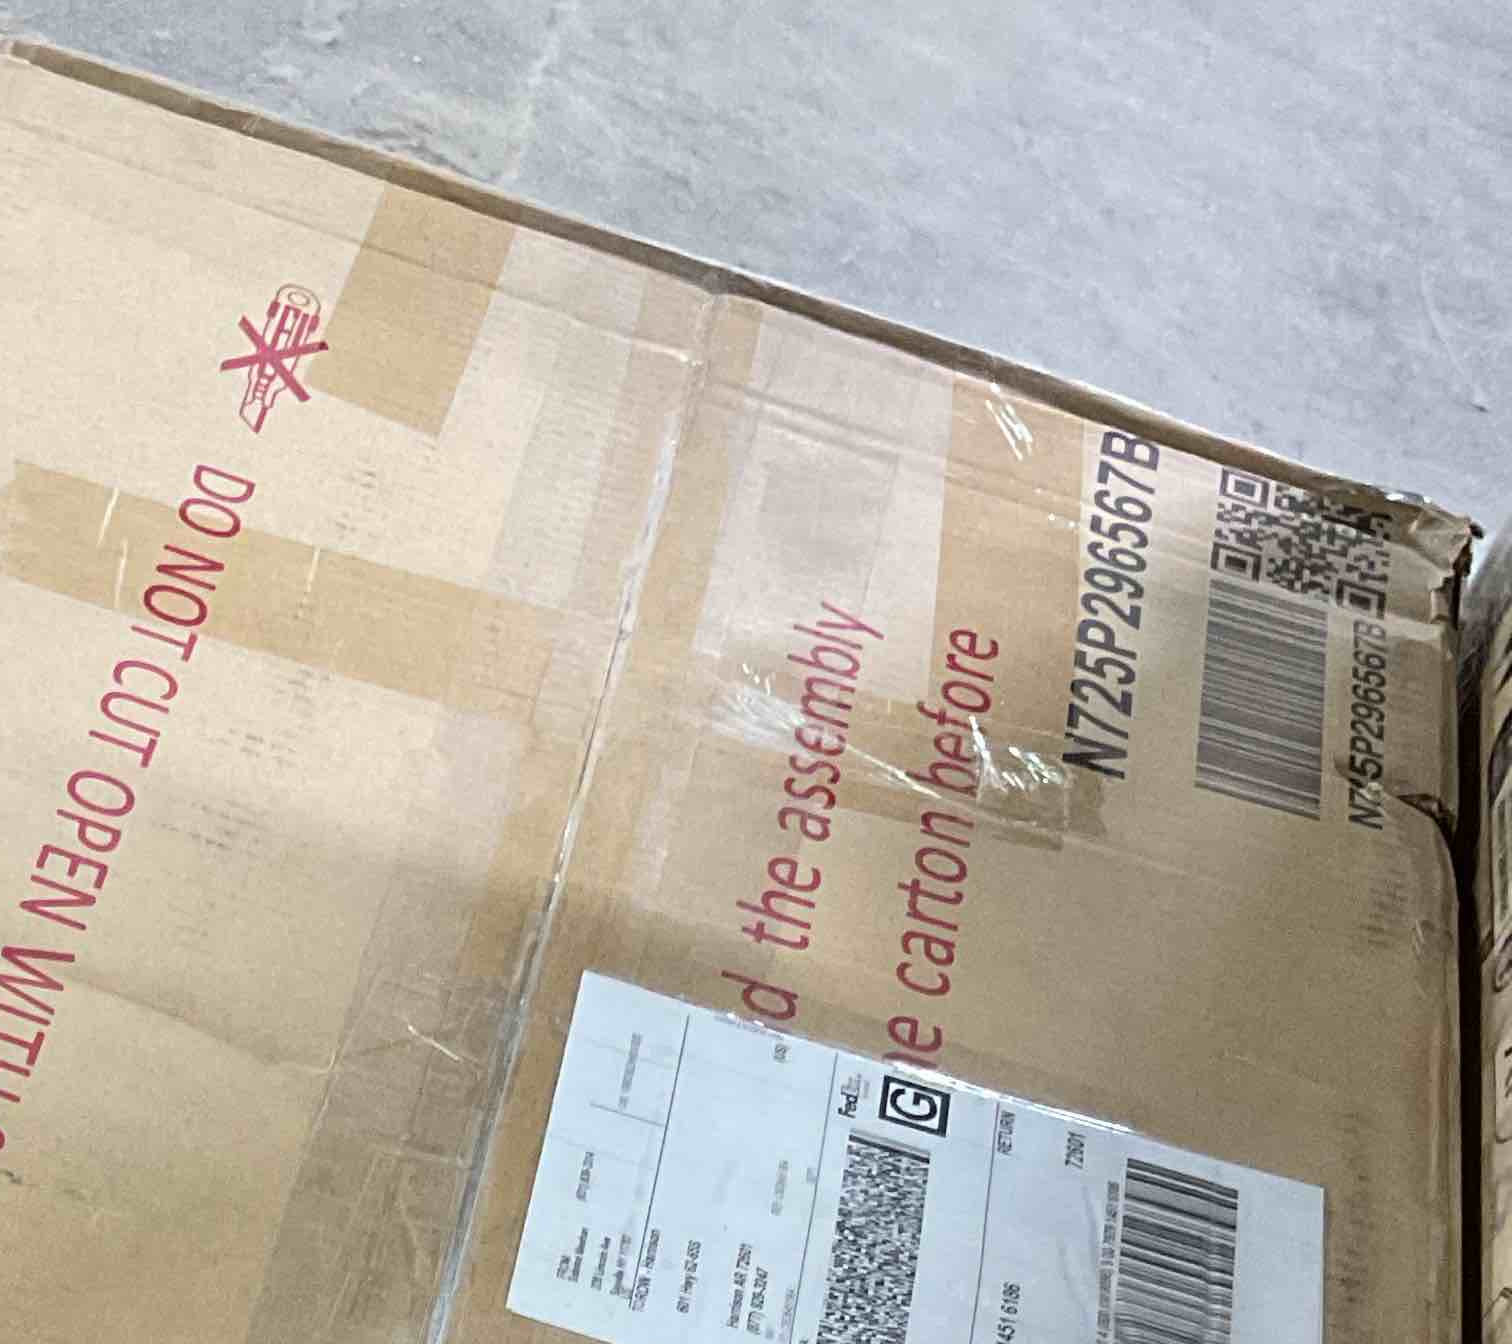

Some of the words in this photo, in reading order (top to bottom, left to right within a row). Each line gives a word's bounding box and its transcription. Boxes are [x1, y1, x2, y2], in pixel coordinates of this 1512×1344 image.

[178, 464, 257, 541] DO
[130, 544, 226, 663] NOT
[1062, 431, 1161, 780] N725P296567B
[89, 660, 180, 769] CUT
[777, 600, 885, 842] assembly
[906, 627, 999, 800] before
[20, 770, 136, 932] OPEN
[736, 856, 822, 951] the
[896, 810, 976, 998] carton
[889, 1086, 939, 1123] G
[997, 1110, 1016, 1156] RETURN
